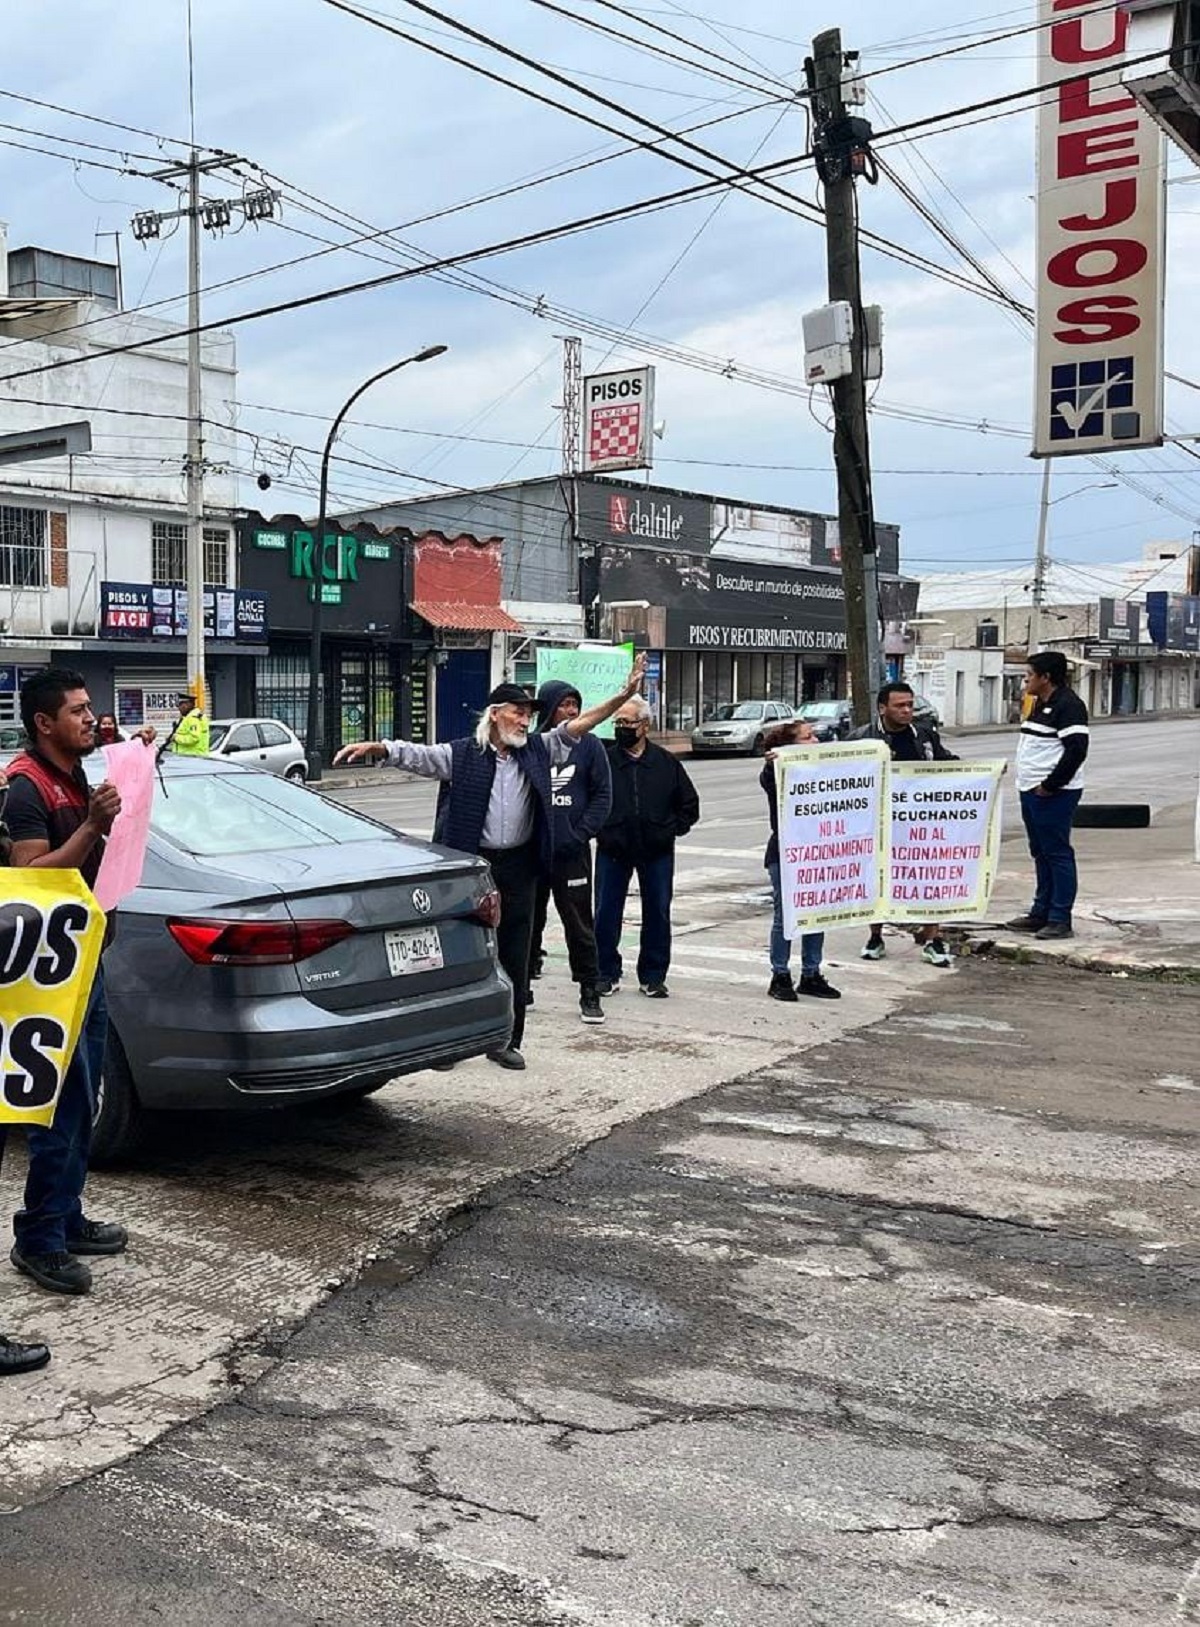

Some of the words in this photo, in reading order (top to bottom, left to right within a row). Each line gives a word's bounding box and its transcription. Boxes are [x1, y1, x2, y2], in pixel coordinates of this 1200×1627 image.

[1047, 0, 1147, 345] ULEJOS
[591, 379, 642, 402] PISOS
[716, 573, 754, 592] Descubre
[755, 580, 765, 592] un
[765, 580, 792, 595] mundo
[792, 581, 802, 596] de
[108, 591, 138, 604] PISOS
[141, 592, 148, 605] Y
[238, 600, 265, 613] ARCE
[110, 611, 148, 626] LACH
[690, 625, 720, 645] PISOS
[721, 627, 730, 646] Y
[730, 627, 815, 648] RECUBRIMIENTOS
[789, 781, 817, 796] JOSE
[818, 775, 875, 793] CHEDRAUI
[912, 790, 988, 802] CHEDRAUI
[794, 797, 869, 817] ESCUCHANOS
[819, 820, 832, 838] NO
[834, 819, 846, 836] AL
[909, 827, 927, 841] NO
[931, 826, 947, 841] AL
[796, 864, 847, 885] ROTATIVO
[848, 862, 861, 879] EN
[949, 865, 964, 880] EN
[829, 883, 869, 904] CAPITAL
[923, 884, 969, 900] CAPITAL
